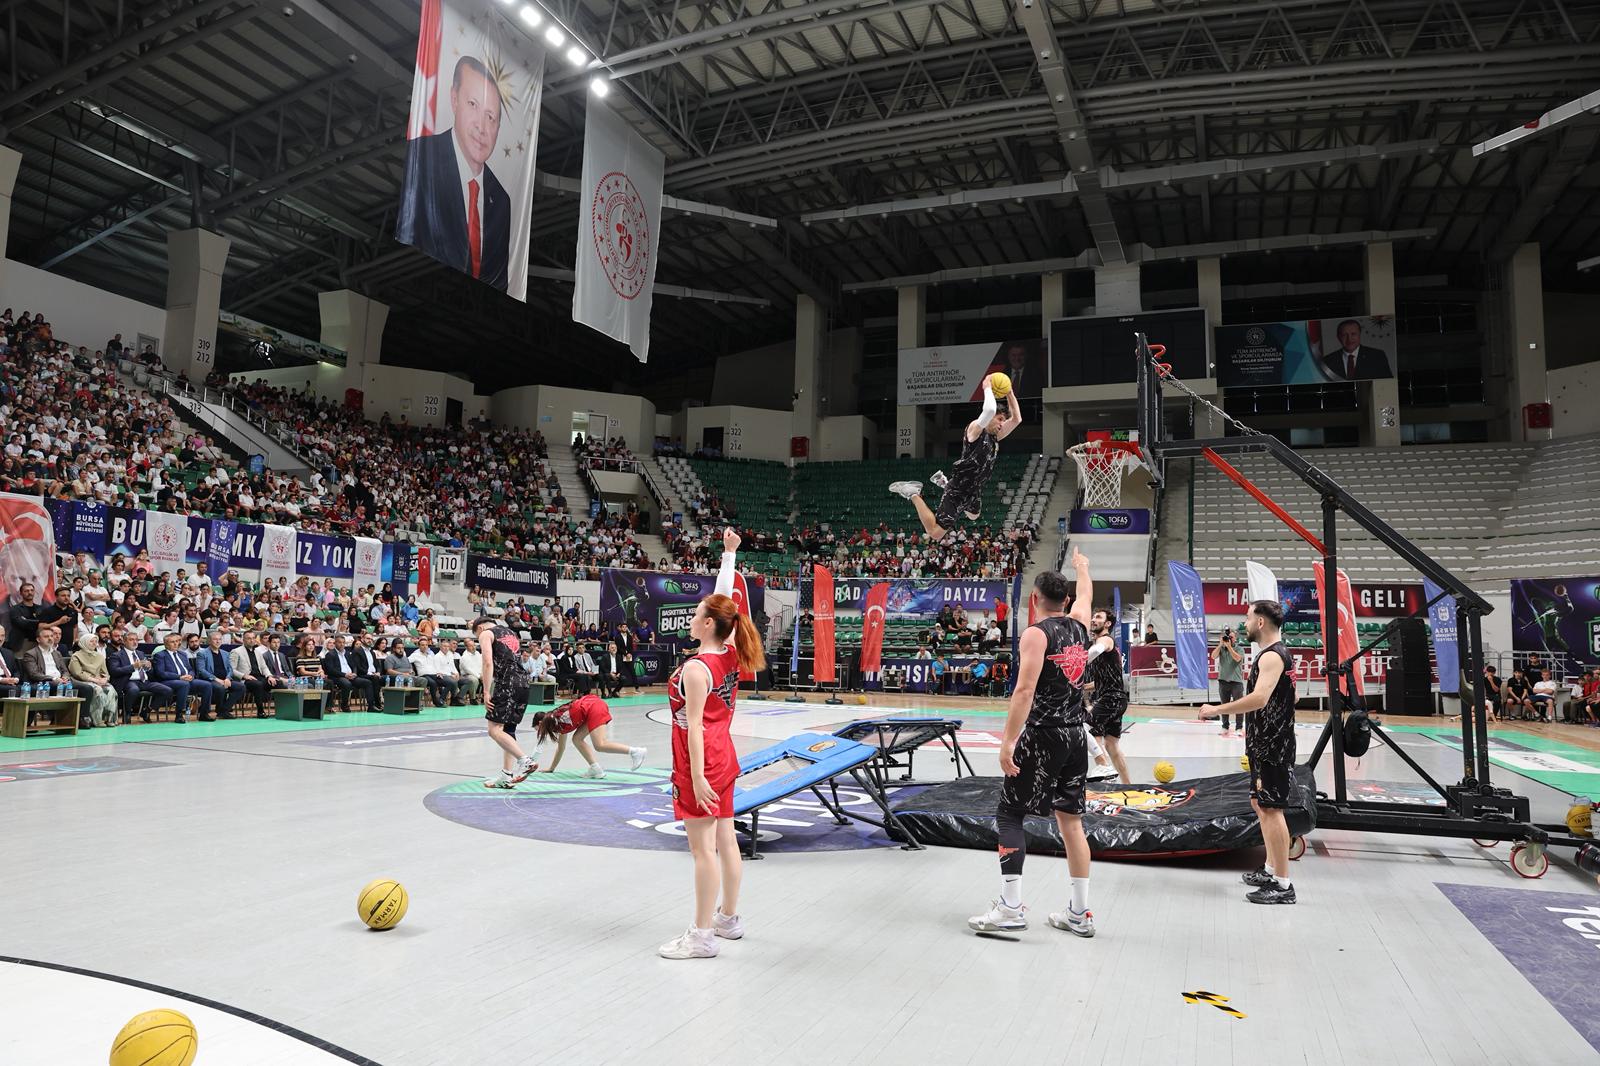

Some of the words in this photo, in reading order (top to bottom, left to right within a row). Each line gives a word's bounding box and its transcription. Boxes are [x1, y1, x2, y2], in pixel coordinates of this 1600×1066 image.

[198, 339, 211, 350] 319
[196, 351, 210, 363] 212
[424, 395, 439, 405] 320
[189, 401, 202, 414] 313
[424, 406, 438, 416] 213
[730, 427, 742, 436] 322
[900, 428, 911, 437] 323
[900, 438, 911, 446] 215
[76, 514, 104, 523] BURSA
[1108, 516, 1128, 525] TOFAŞ
[321, 544, 354, 569] YOK
[440, 557, 458, 571] 110
[476, 562, 549, 589] #BenimTakımımTOFAŞ
[681, 582, 699, 591] TOFAŞ
[944, 586, 986, 602] DAYIZ
[1360, 589, 1405, 608] GEL!
[662, 608, 688, 617] BASKETBOL
[661, 615, 693, 632] BURS
[373, 898, 398, 925] TARMAK
